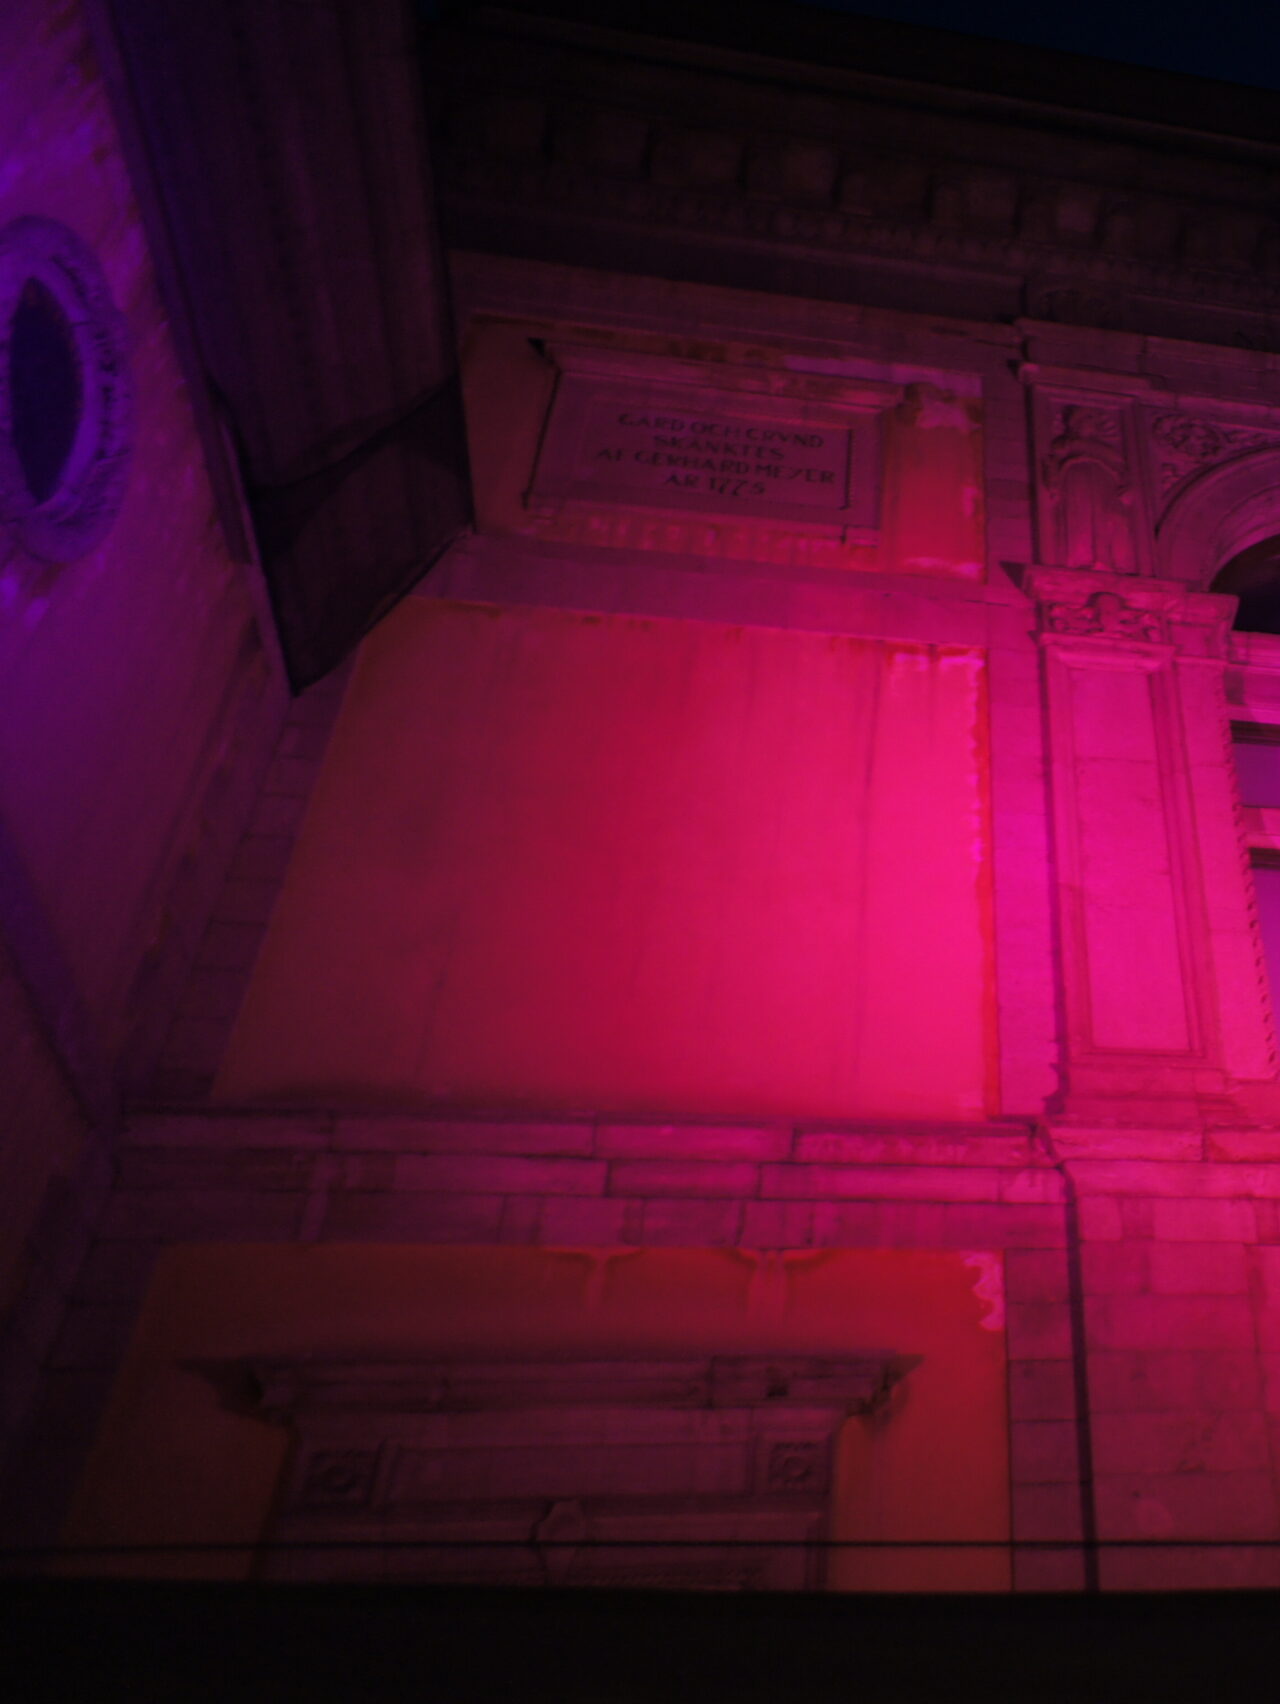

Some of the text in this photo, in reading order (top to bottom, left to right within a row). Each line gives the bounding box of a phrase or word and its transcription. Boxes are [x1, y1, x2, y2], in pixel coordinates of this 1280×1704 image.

[690, 421, 741, 438] OCH
[634, 450, 750, 475] GERHARD
[755, 464, 836, 485] MEYER
